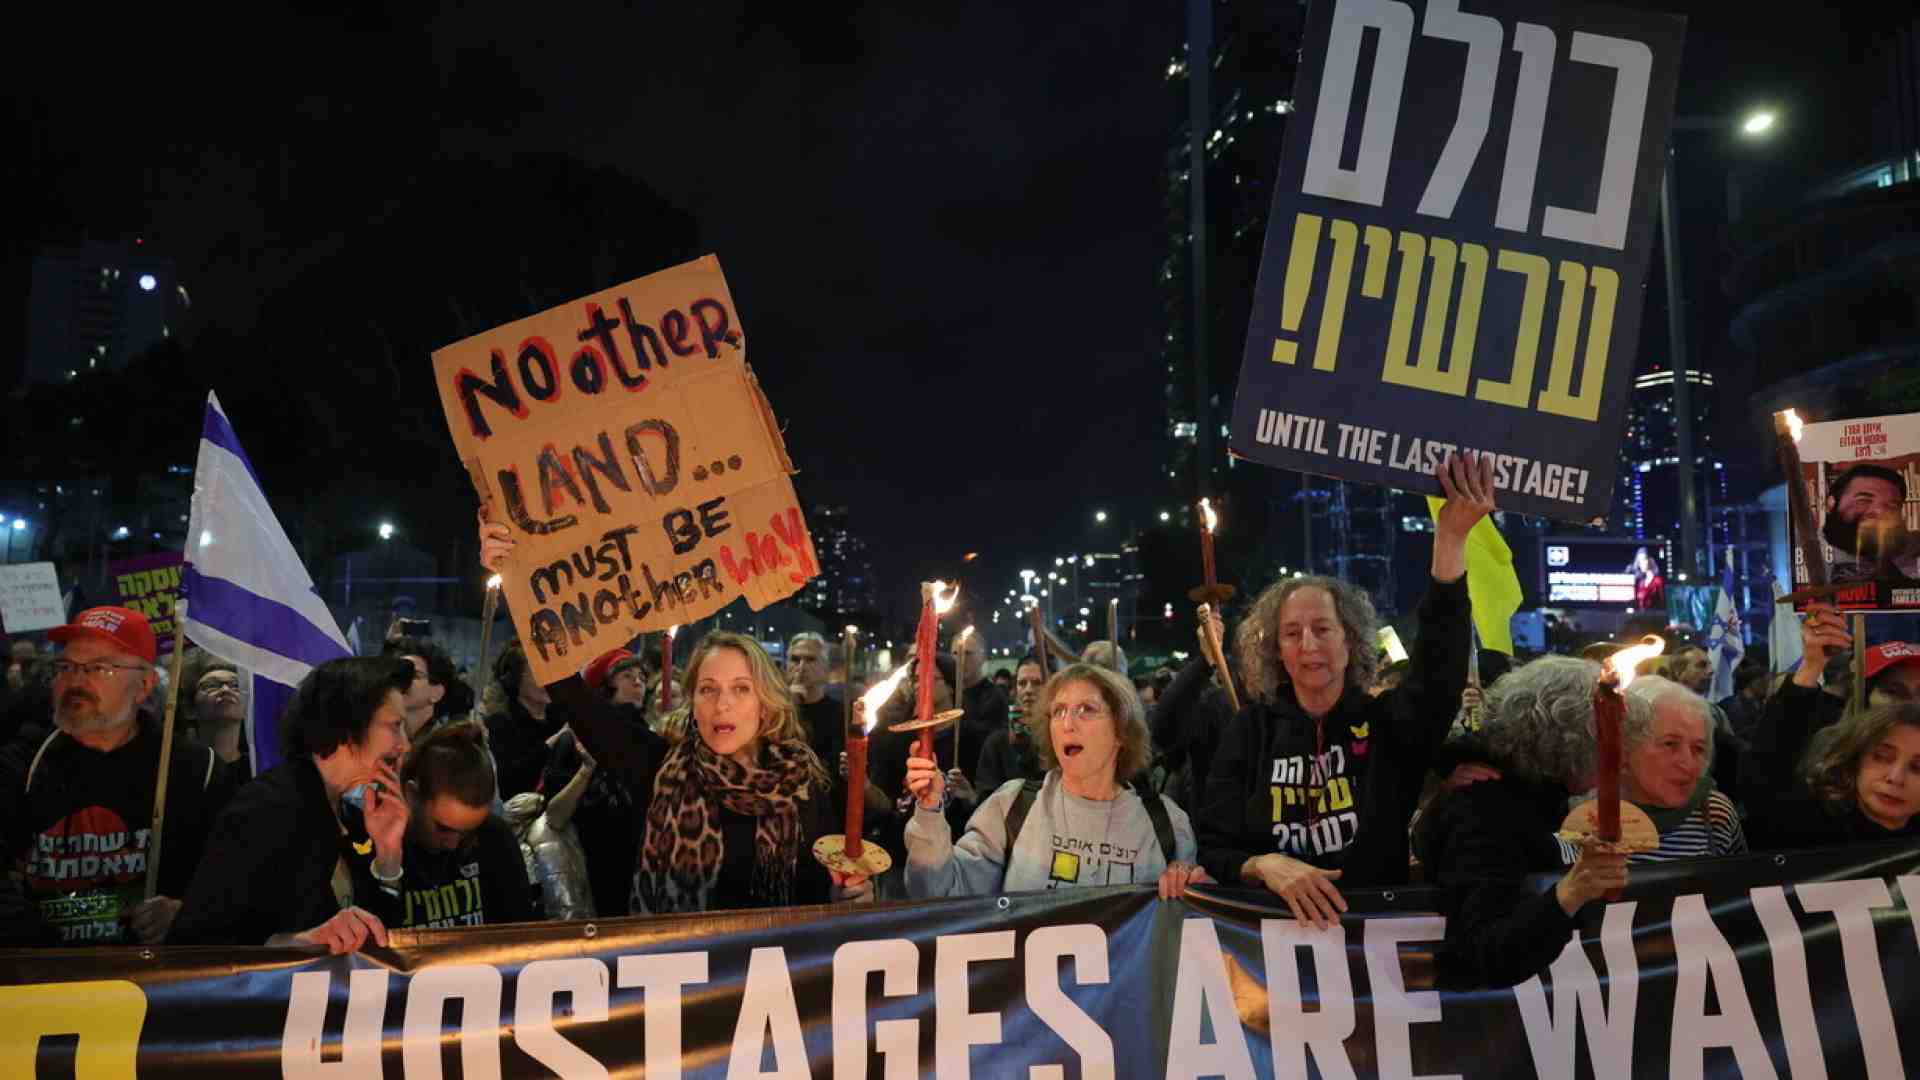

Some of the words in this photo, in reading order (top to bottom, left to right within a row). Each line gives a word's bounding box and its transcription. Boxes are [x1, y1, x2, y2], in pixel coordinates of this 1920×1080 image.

[1301, 0, 1653, 250] כולם
[1272, 212, 1621, 422] עכשיו!
[454, 335, 562, 437] NO
[1255, 408, 1329, 455] UNTIL
[1336, 423, 1390, 467] THE
[1388, 433, 1457, 476] LAST
[1463, 446, 1590, 505] STAGE!
[663, 496, 731, 555] BE
[1271, 755, 1303, 783] הם
[1052, 834, 1093, 852] אותם
[281, 923, 1115, 1080] HOSTAGES
[1165, 915, 1464, 1080] ARE
